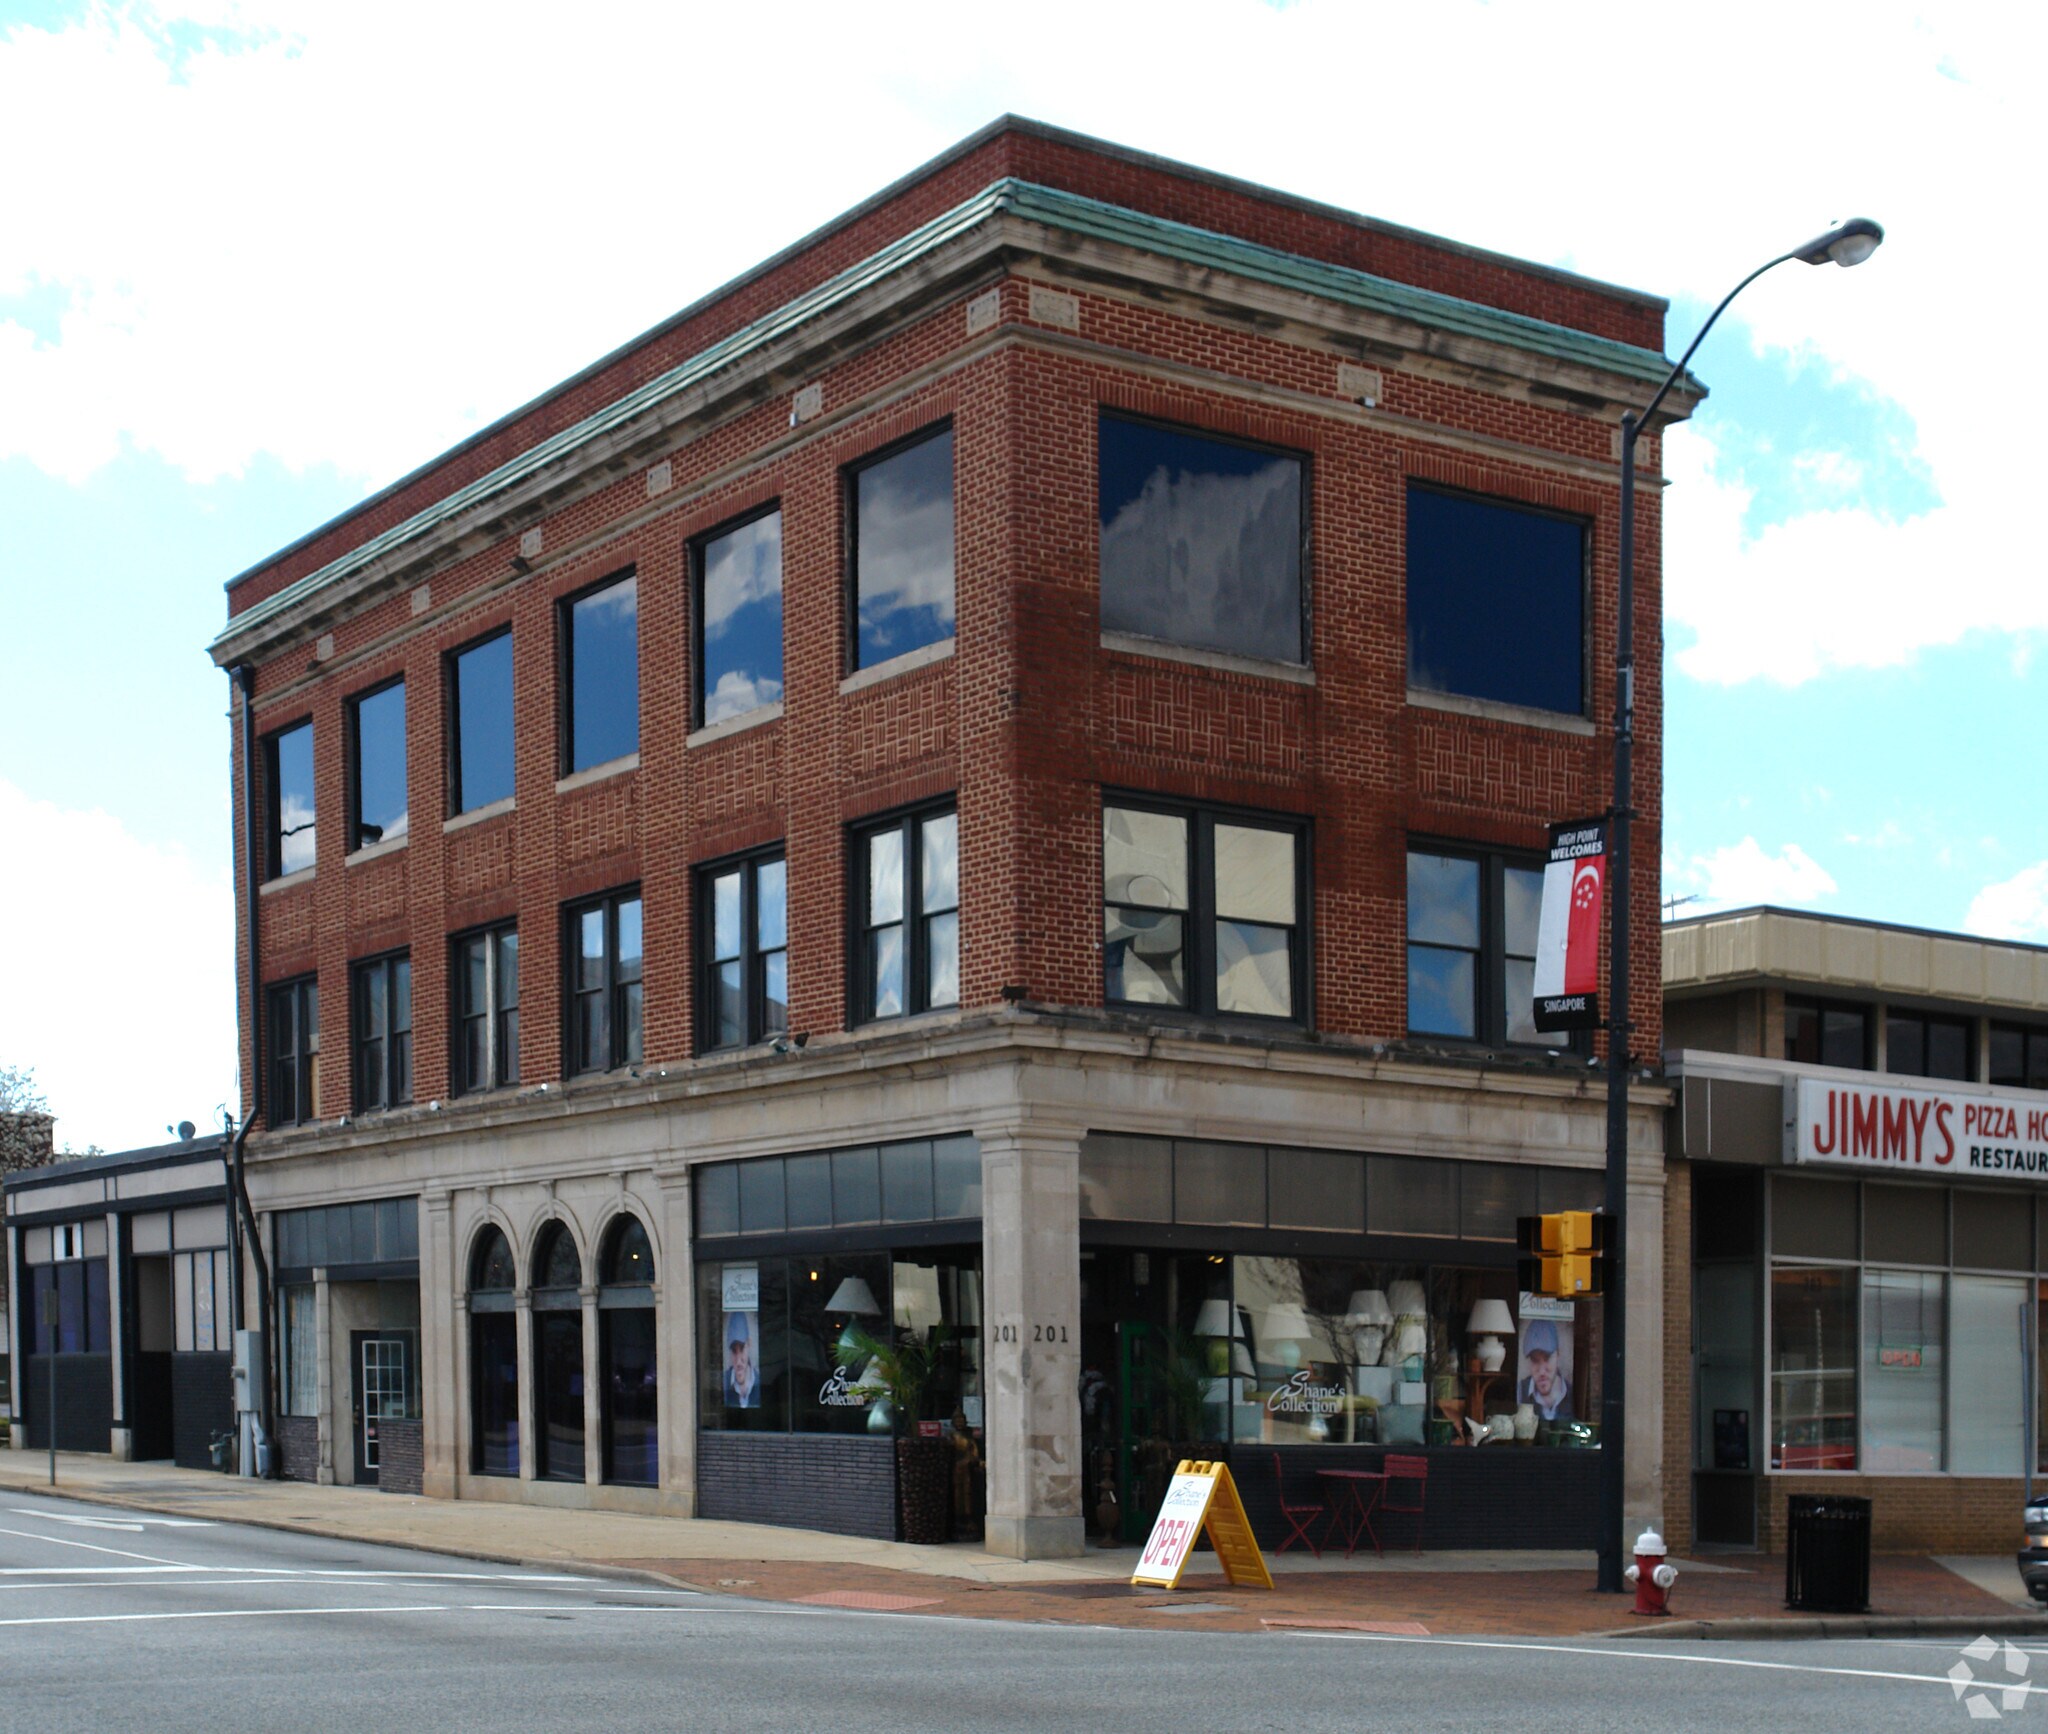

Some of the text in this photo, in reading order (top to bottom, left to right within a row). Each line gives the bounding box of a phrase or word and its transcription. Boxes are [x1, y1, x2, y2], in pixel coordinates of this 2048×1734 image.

[1558, 827, 1599, 846] HIGH POINT
[1551, 840, 1603, 860] WELCOMES
[1544, 997, 1586, 1013] SINGAPORE
[1814, 1089, 1956, 1165] JIMMY'S
[1964, 1104, 2019, 1140] PIZZA
[993, 1325, 1017, 1343] 201
[1034, 1325, 1068, 1343] 201
[819, 1379, 865, 1406] Collection
[1284, 1370, 1346, 1398] Shane's
[1267, 1384, 1338, 1413] Collection
[1143, 1518, 1195, 1567] OPEN
